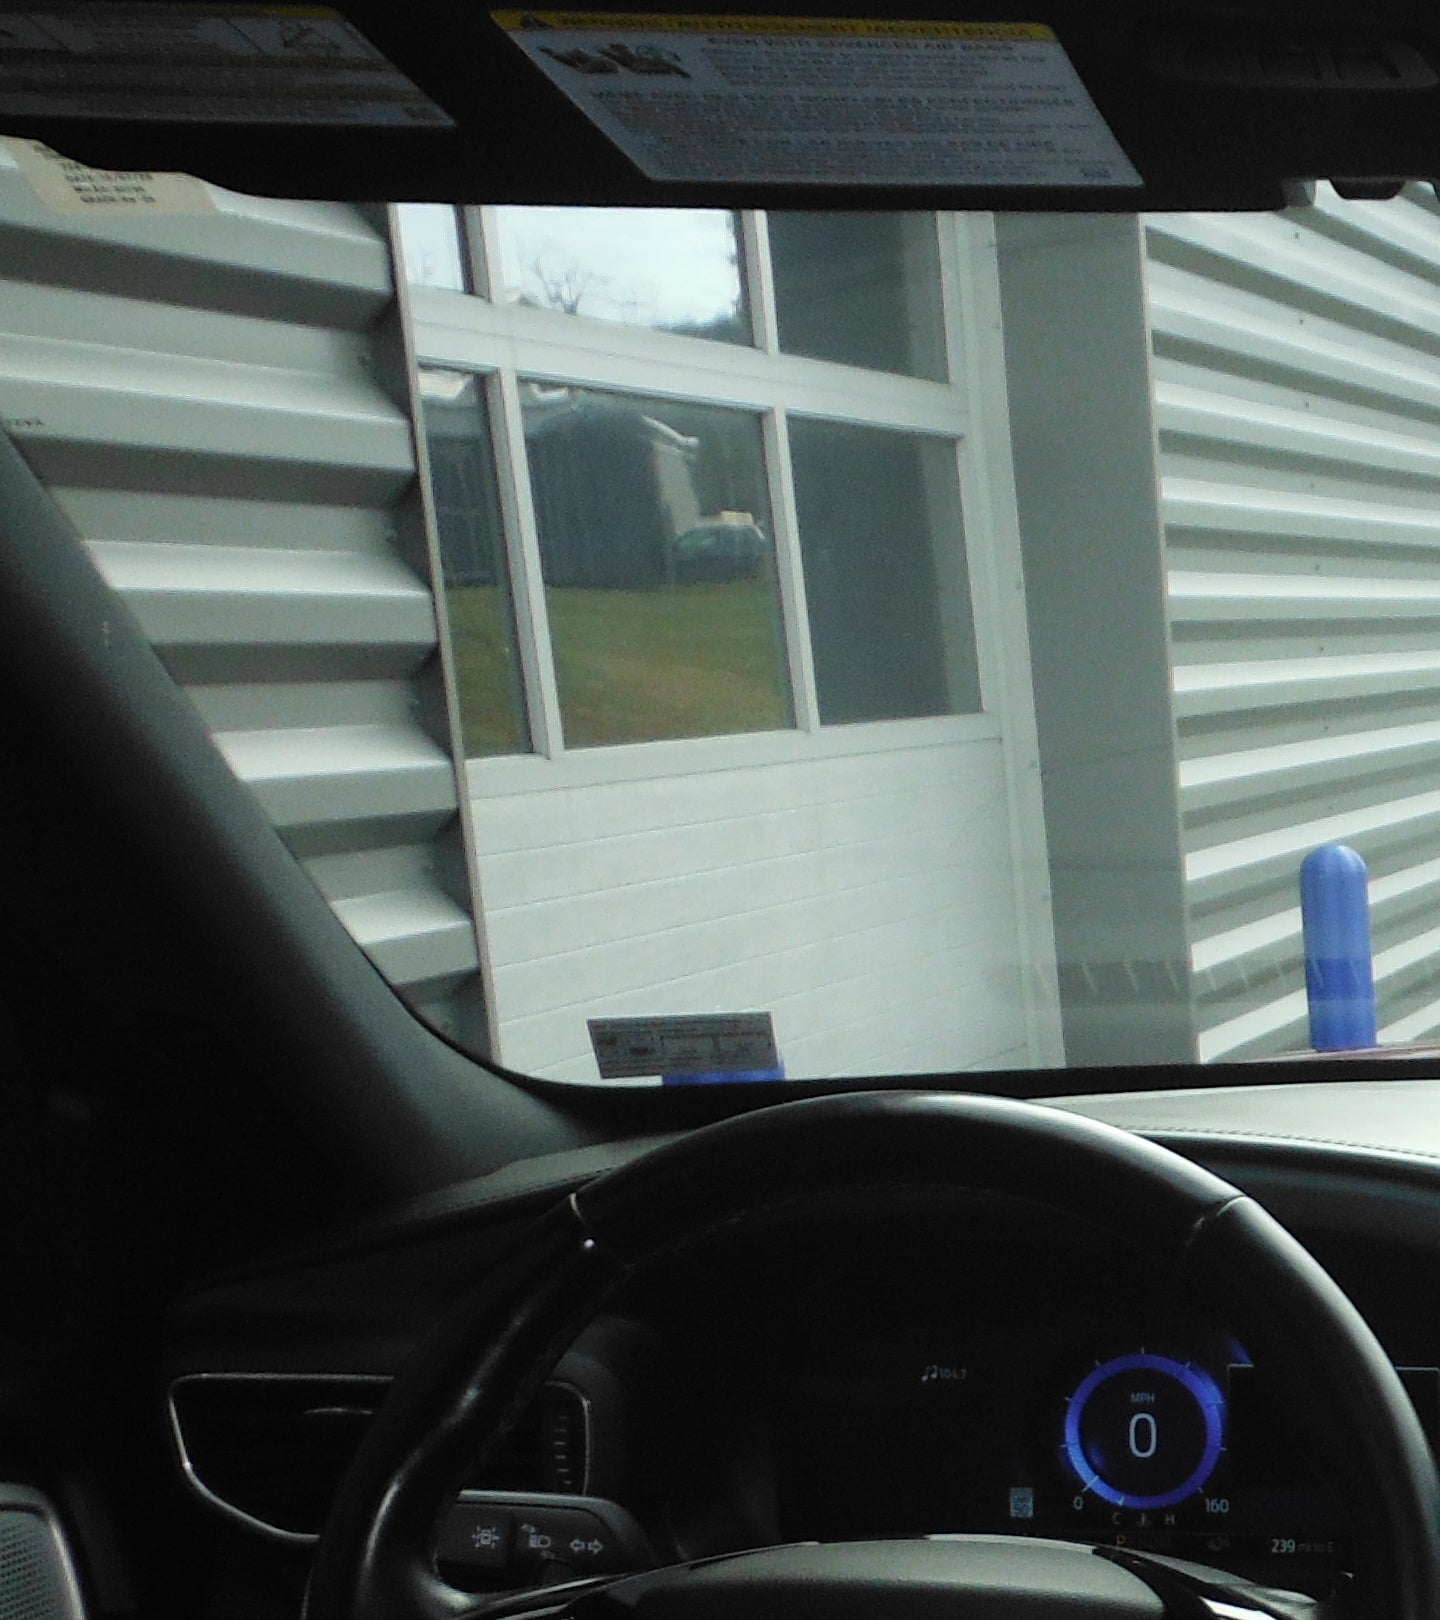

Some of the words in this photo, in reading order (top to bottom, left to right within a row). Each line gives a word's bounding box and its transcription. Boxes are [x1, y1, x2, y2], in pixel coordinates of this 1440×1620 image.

[1130, 1392, 1156, 1404] MPH
[1128, 1412, 1158, 1458] 0
[1073, 1495, 1084, 1511] 0
[1204, 1498, 1231, 1513] 160
[1271, 1538, 1297, 1553] 239
